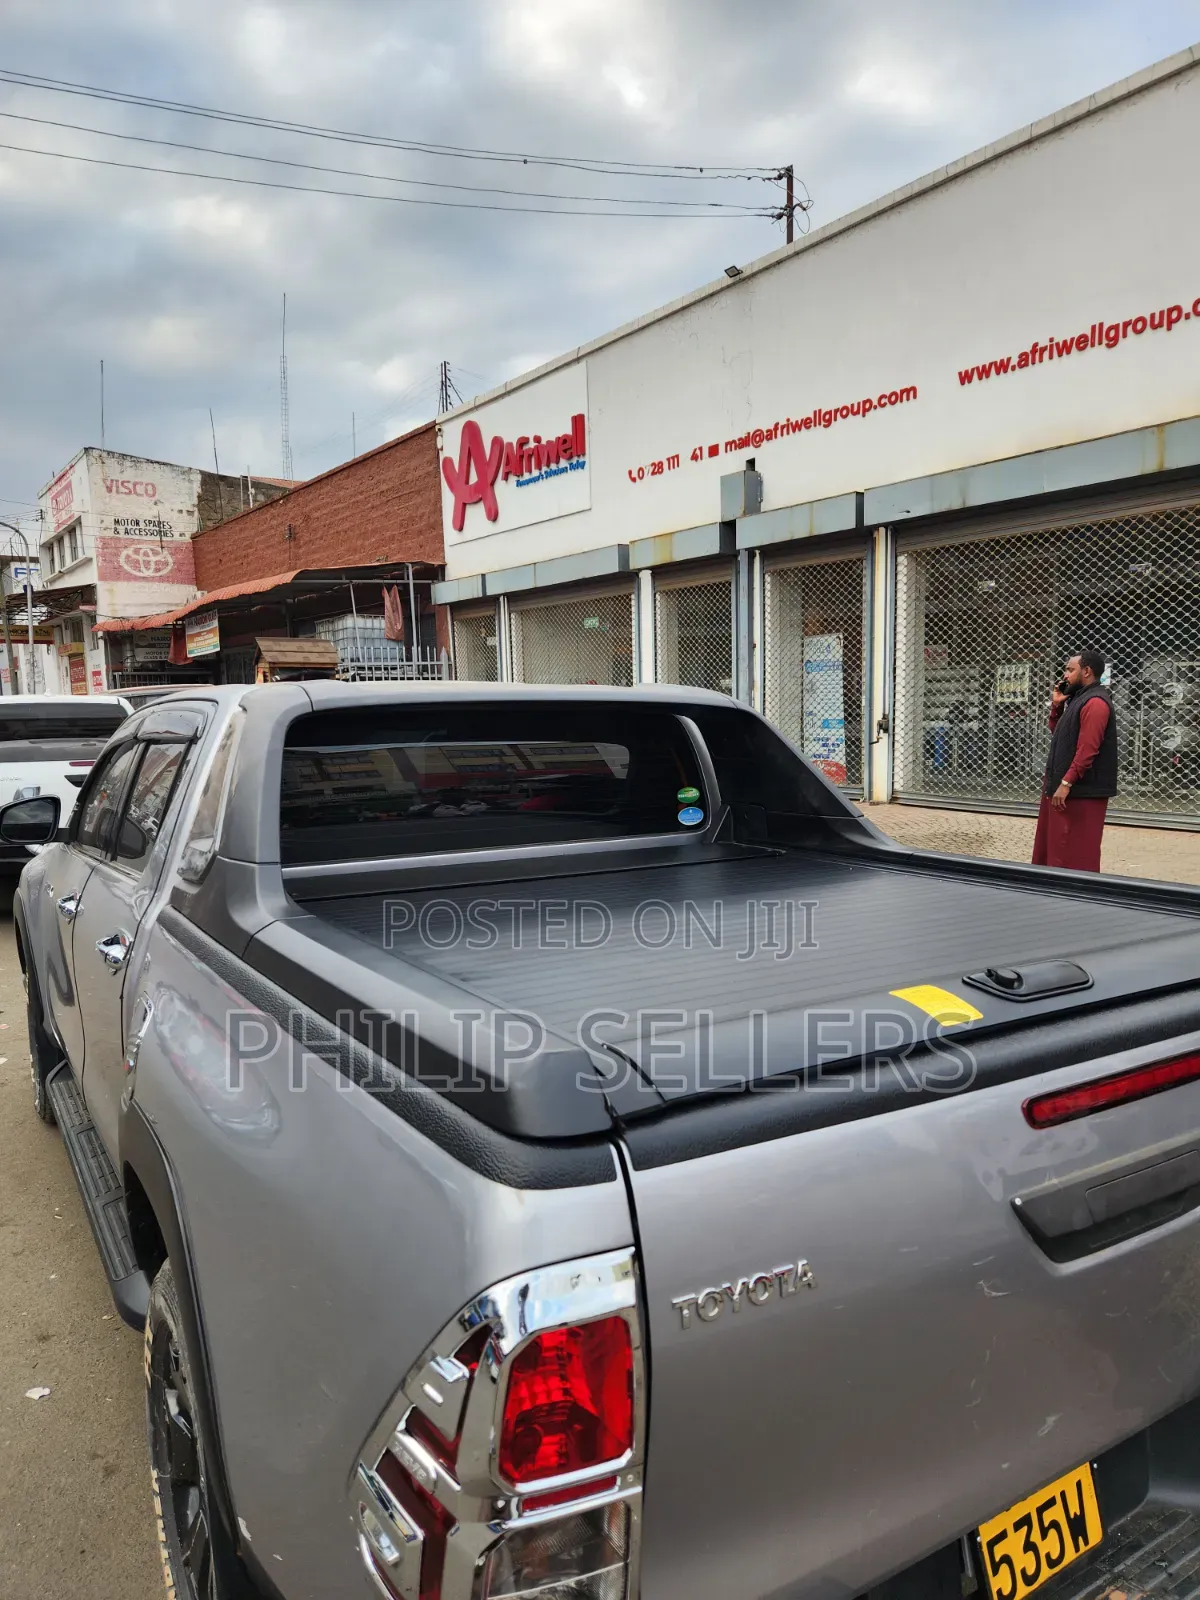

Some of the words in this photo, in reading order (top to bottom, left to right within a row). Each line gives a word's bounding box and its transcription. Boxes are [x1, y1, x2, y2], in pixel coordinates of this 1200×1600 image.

[502, 413, 586, 482] Afriwell
[724, 384, 918, 455] mail@afriwellgroup.com
[103, 478, 157, 498] VISCO
[113, 518, 140, 527] MOTOR
[143, 519, 172, 529] SPARES
[113, 527, 120, 535] &
[124, 527, 174, 538] ACCESSORIES
[671, 1258, 818, 1330] TOYOTA
[986, 1479, 1090, 1600] 535W
